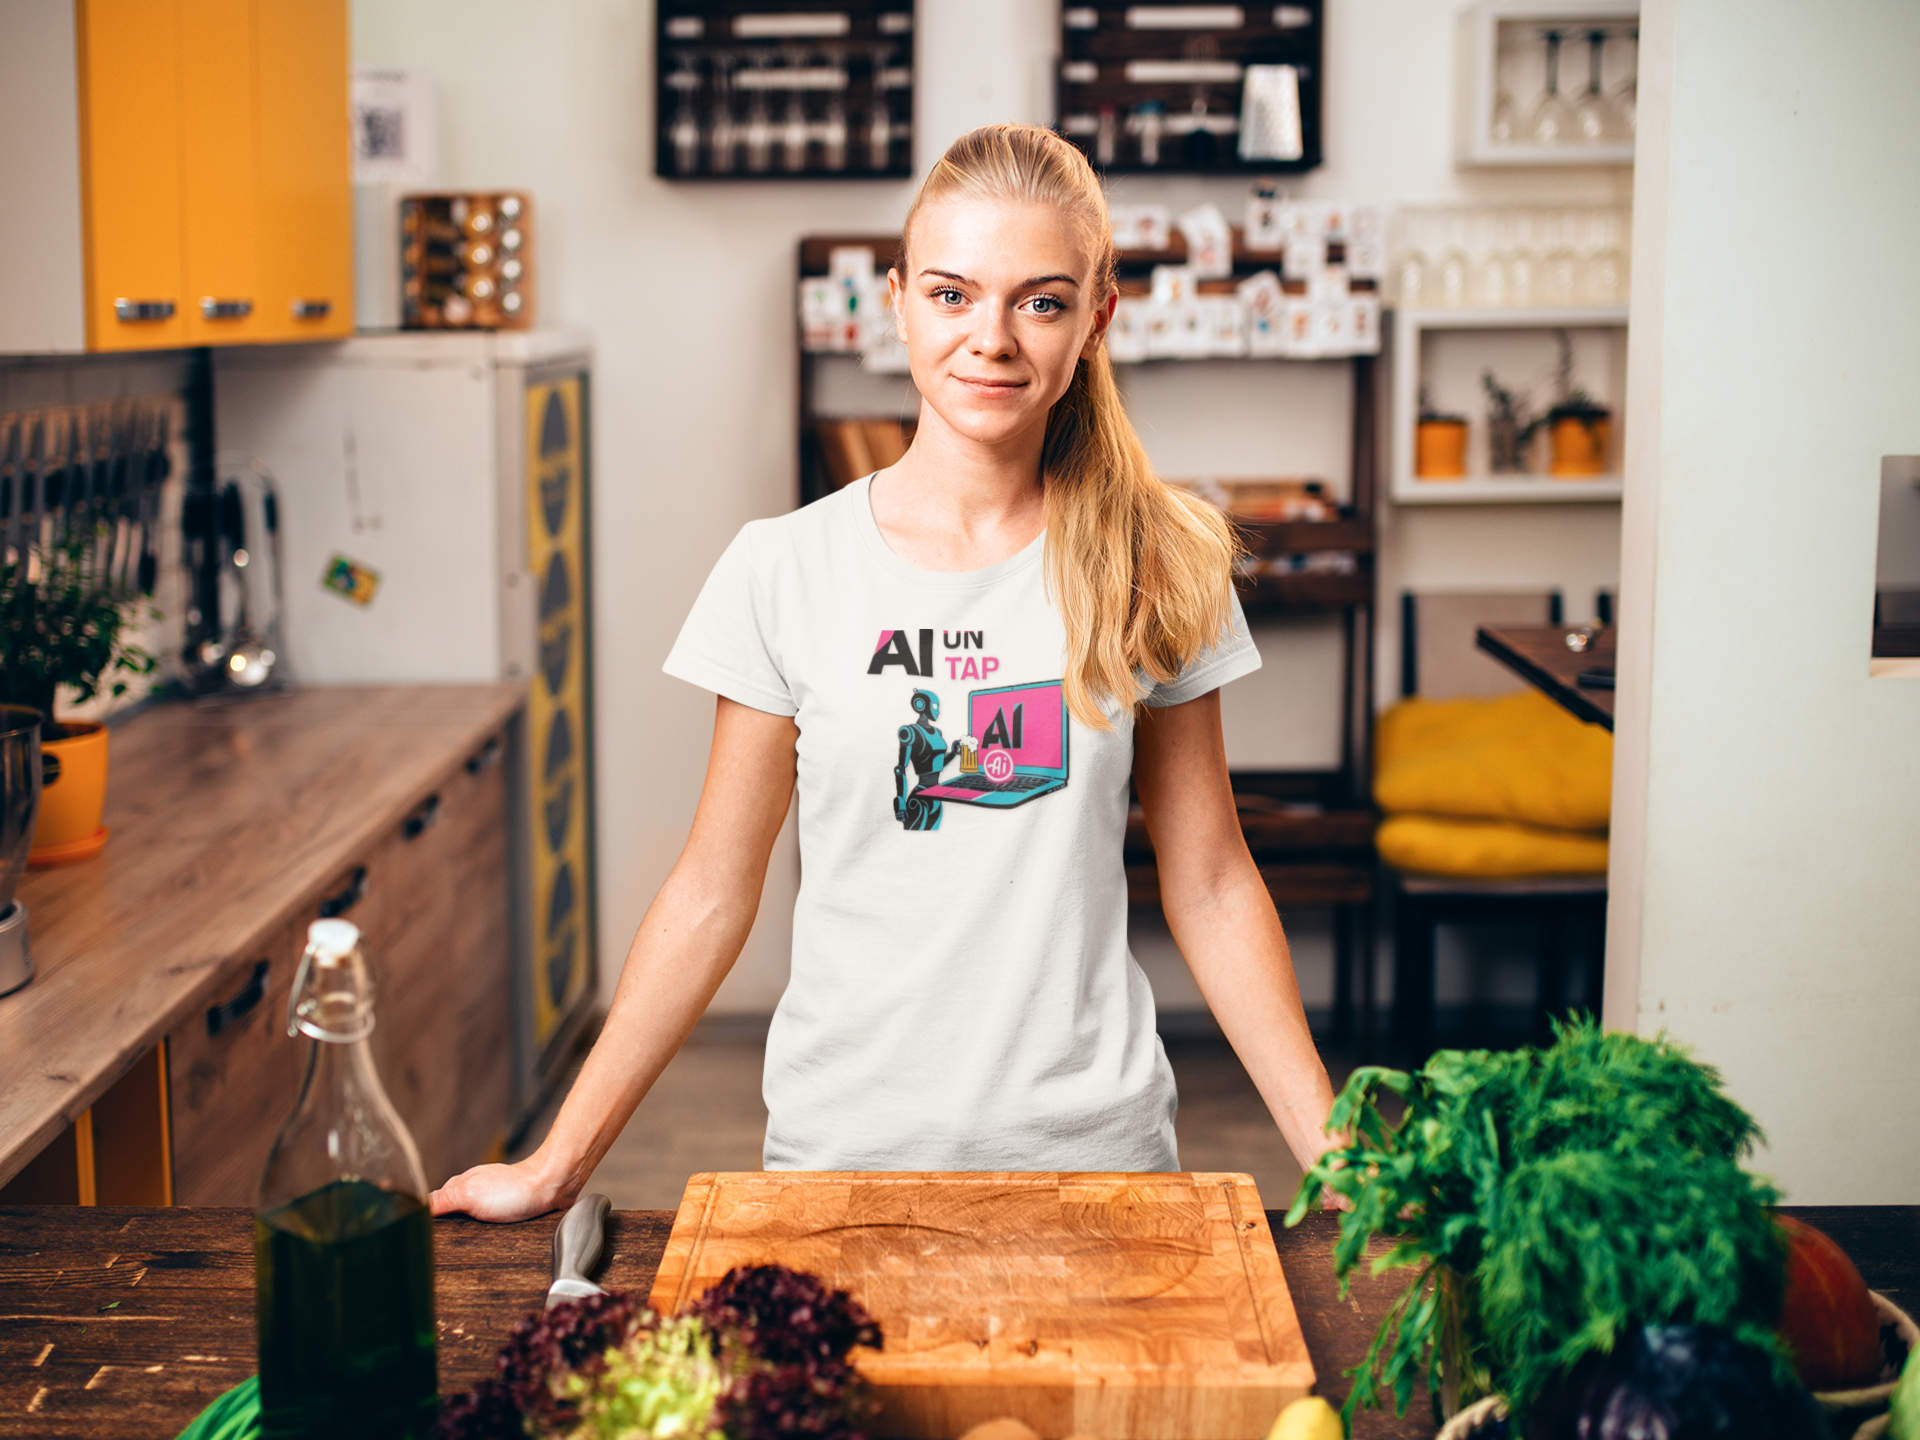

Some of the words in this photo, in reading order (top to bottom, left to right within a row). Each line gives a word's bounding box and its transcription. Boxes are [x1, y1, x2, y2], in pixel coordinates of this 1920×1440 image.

[867, 629, 933, 677] AI
[943, 630, 983, 649] UN
[944, 656, 999, 680] TAP
[981, 703, 1023, 749] AI
